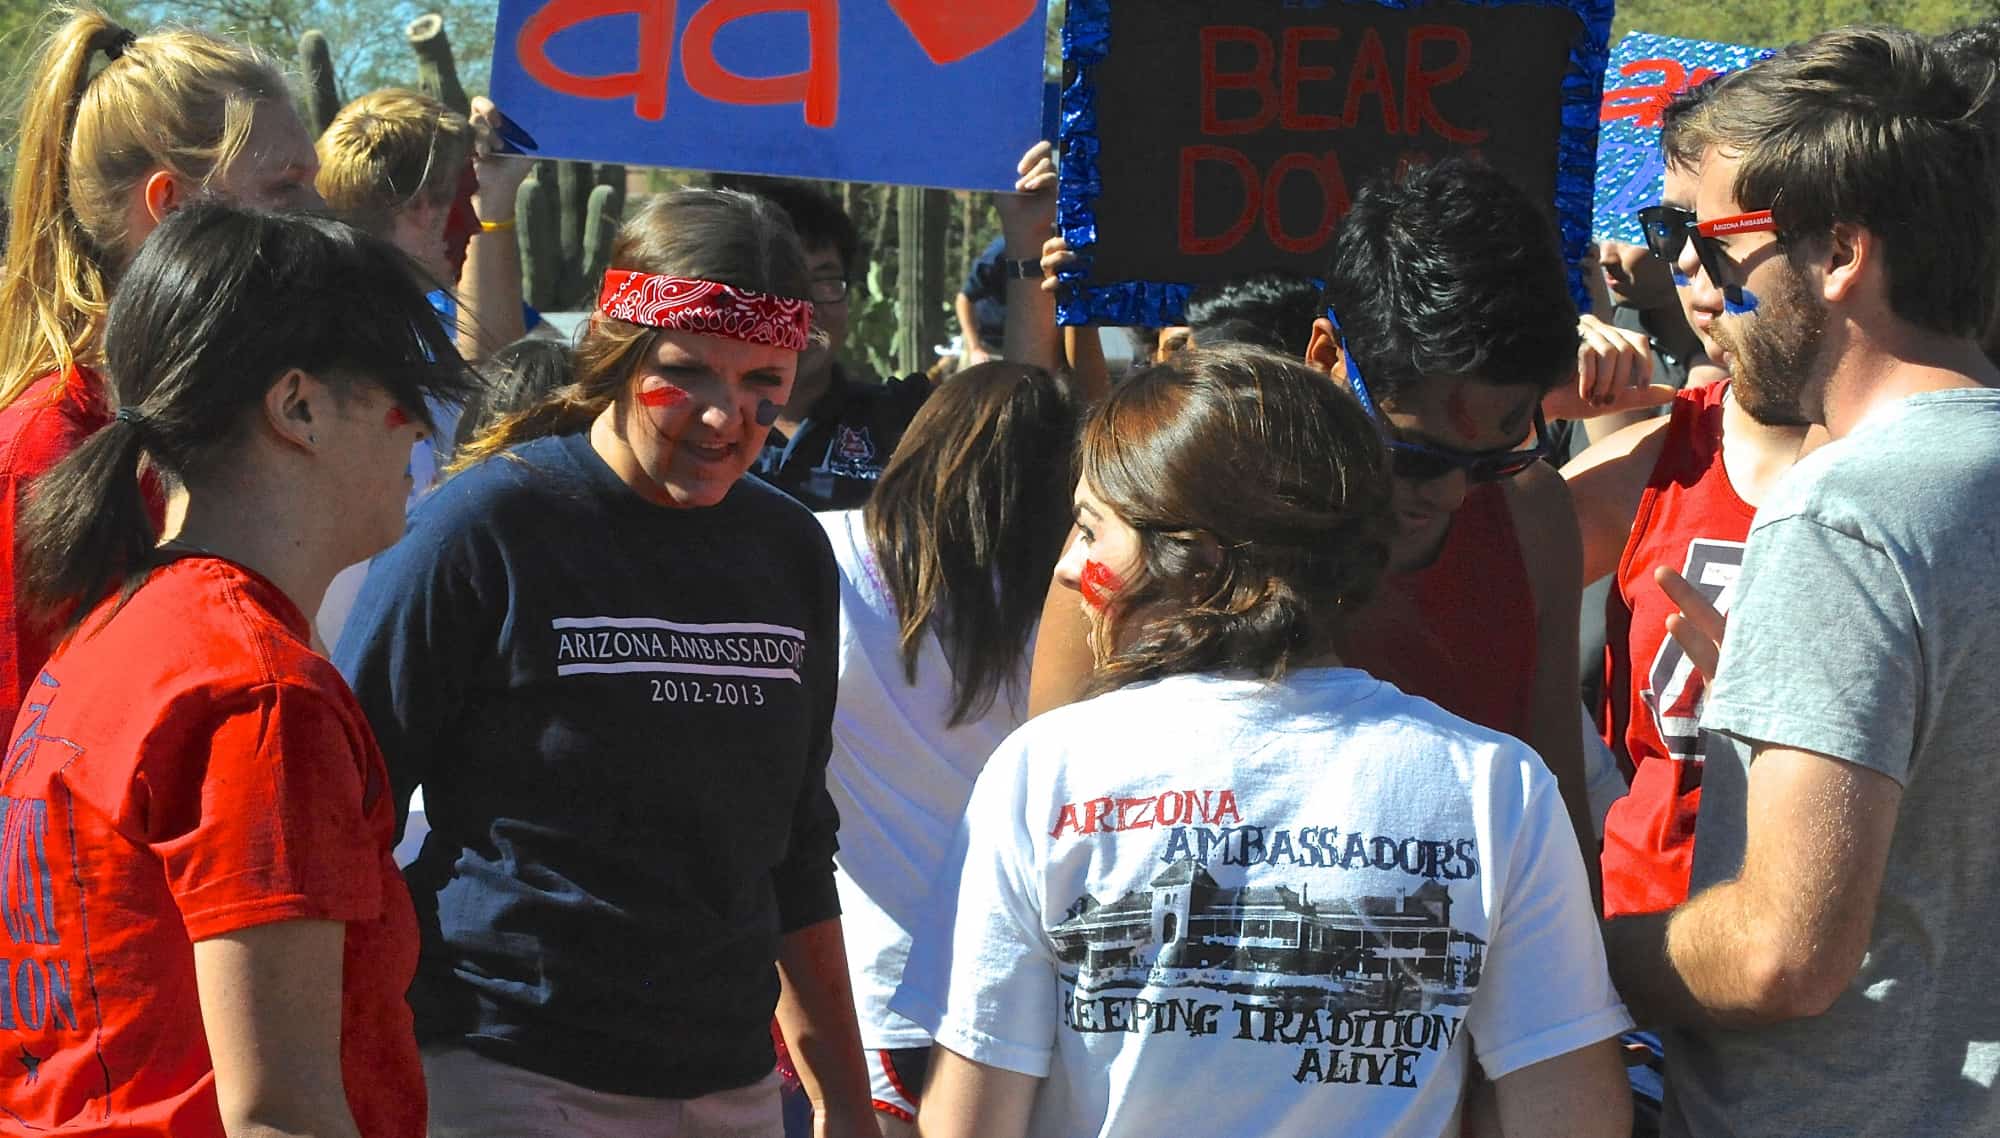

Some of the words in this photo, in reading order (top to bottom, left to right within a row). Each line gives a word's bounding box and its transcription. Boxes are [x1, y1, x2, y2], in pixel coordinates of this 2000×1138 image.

[1199, 25, 1488, 144] BEAR
[557, 632, 667, 660] ARIZONA
[650, 679, 765, 706] 2012-2013
[1048, 789, 1244, 840] ARIZONA
[1160, 825, 1479, 881] AMBASSADORS
[1064, 991, 1224, 1037] KEEPING
[1232, 1000, 1462, 1051] TRADITION
[1292, 1048, 1421, 1089] ALIVE
